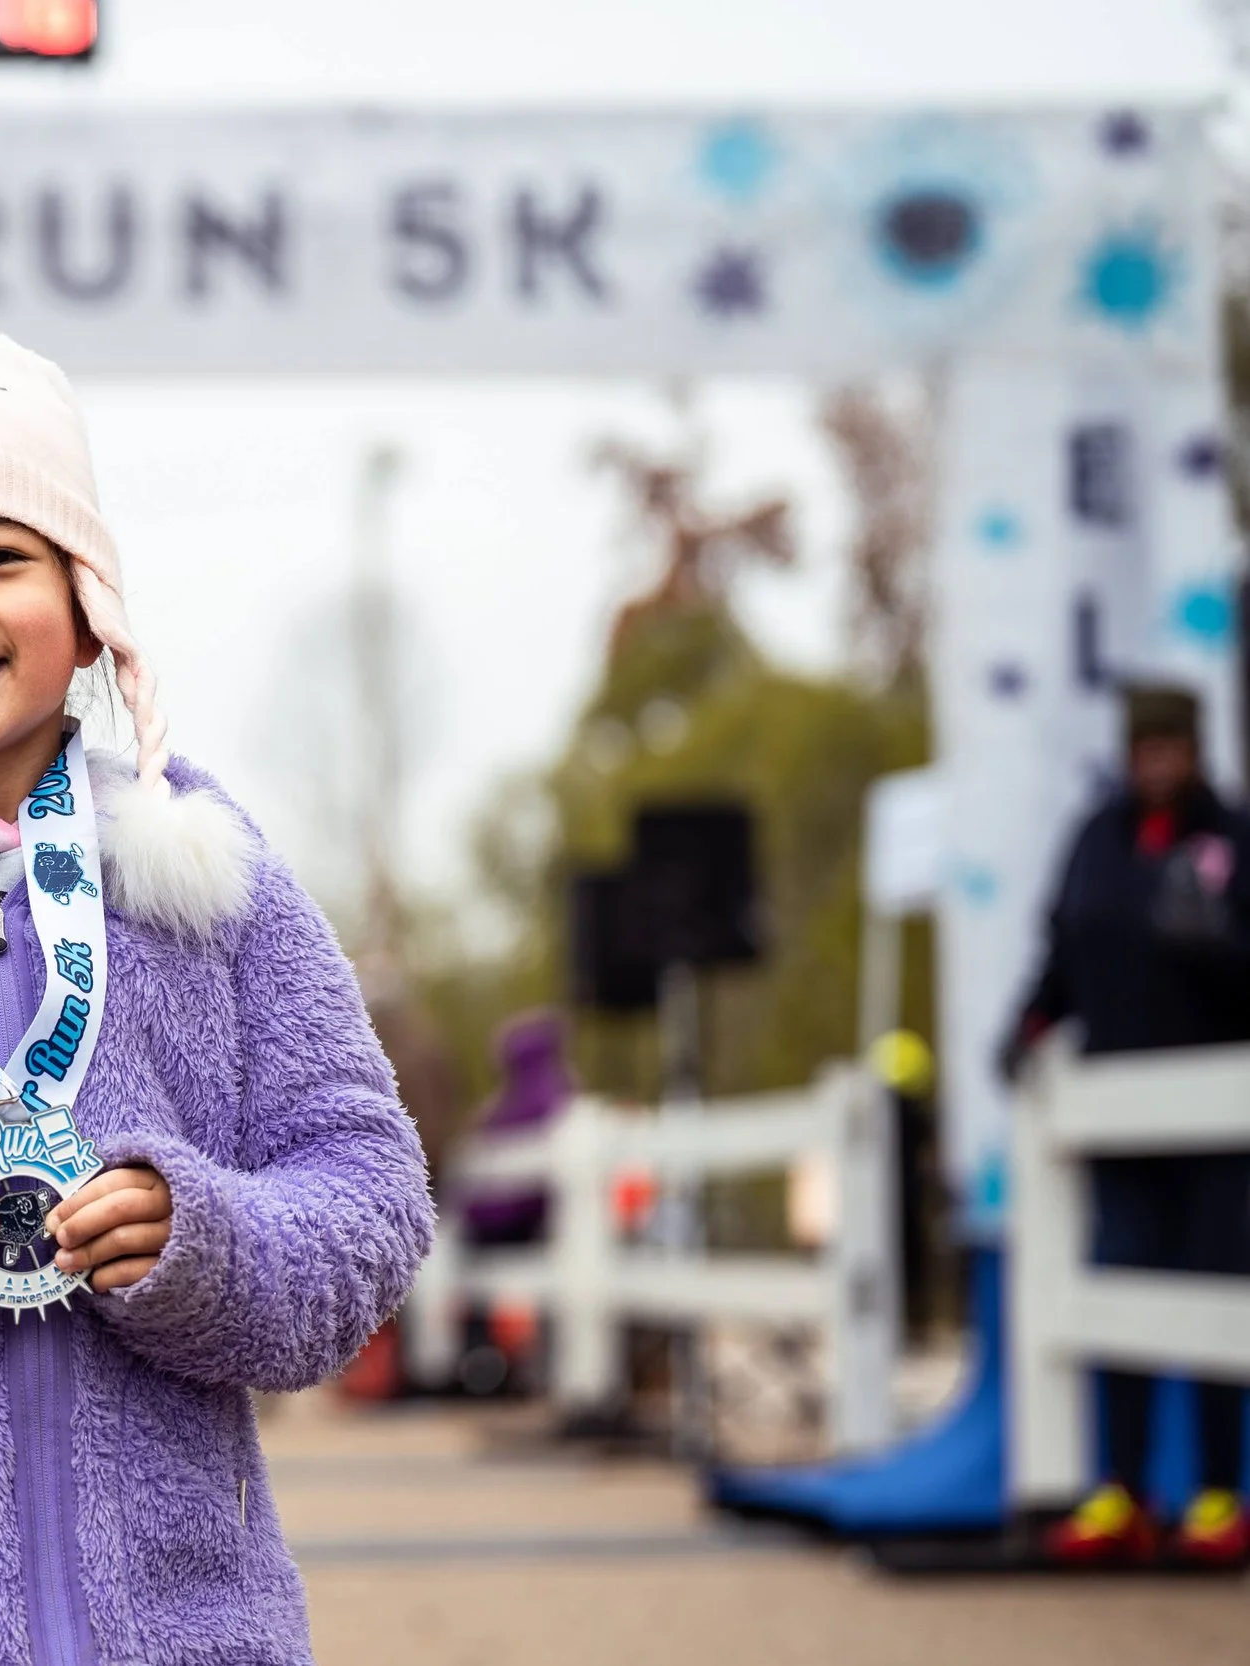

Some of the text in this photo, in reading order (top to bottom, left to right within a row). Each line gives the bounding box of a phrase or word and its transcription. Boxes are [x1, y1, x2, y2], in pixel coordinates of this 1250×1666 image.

[387, 185, 608, 304] 5K
[53, 936, 95, 994] 5k
[25, 993, 91, 1081] Run
